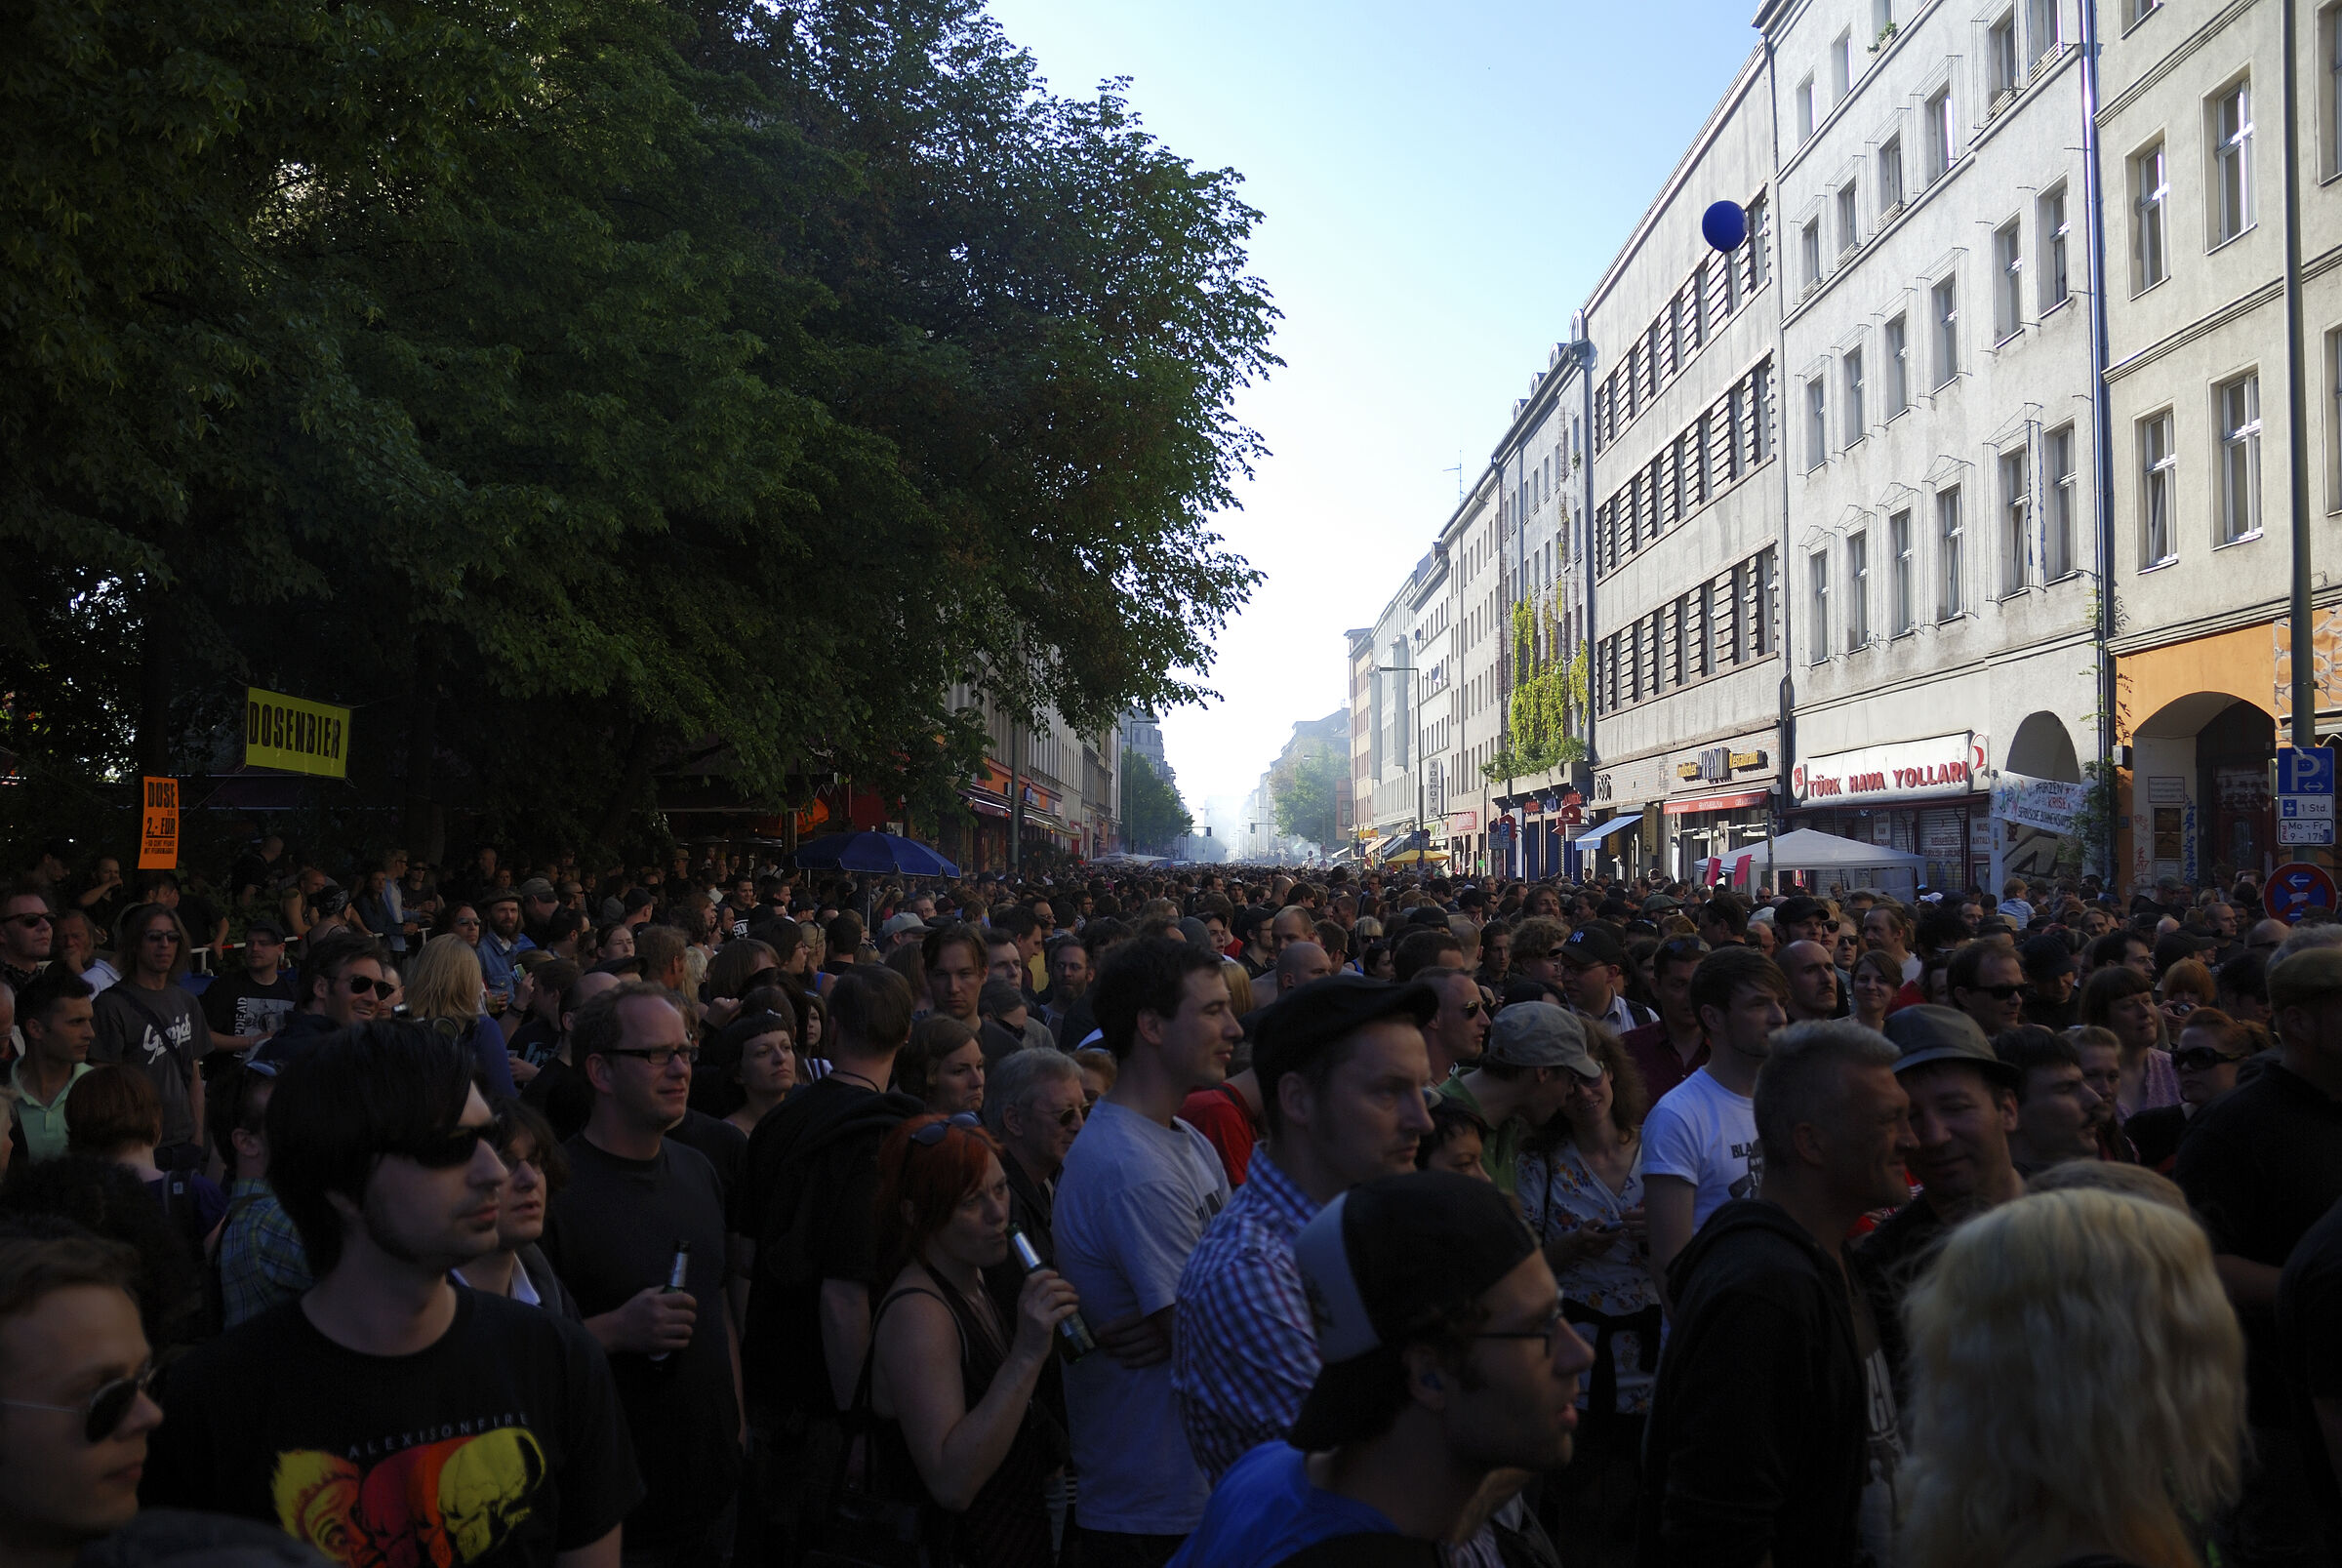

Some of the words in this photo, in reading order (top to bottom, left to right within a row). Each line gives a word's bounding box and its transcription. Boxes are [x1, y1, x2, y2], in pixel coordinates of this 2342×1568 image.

[249, 701, 341, 759] DOSENBIER
[1808, 775, 1841, 797] TÜRK
[1849, 772, 1887, 793] HAVA
[1892, 760, 1968, 788] YOLLARI
[2290, 754, 2321, 791] P
[147, 783, 176, 808] DOSE
[2301, 804, 2305, 813] 1
[2309, 804, 2328, 813] Std.
[160, 817, 176, 835] EUR
[2287, 822, 2304, 830] Mo
[2313, 822, 2323, 830] Fr
[2289, 832, 2296, 841] 9
[347, 1412, 529, 1458] ALEXISONFIRE
